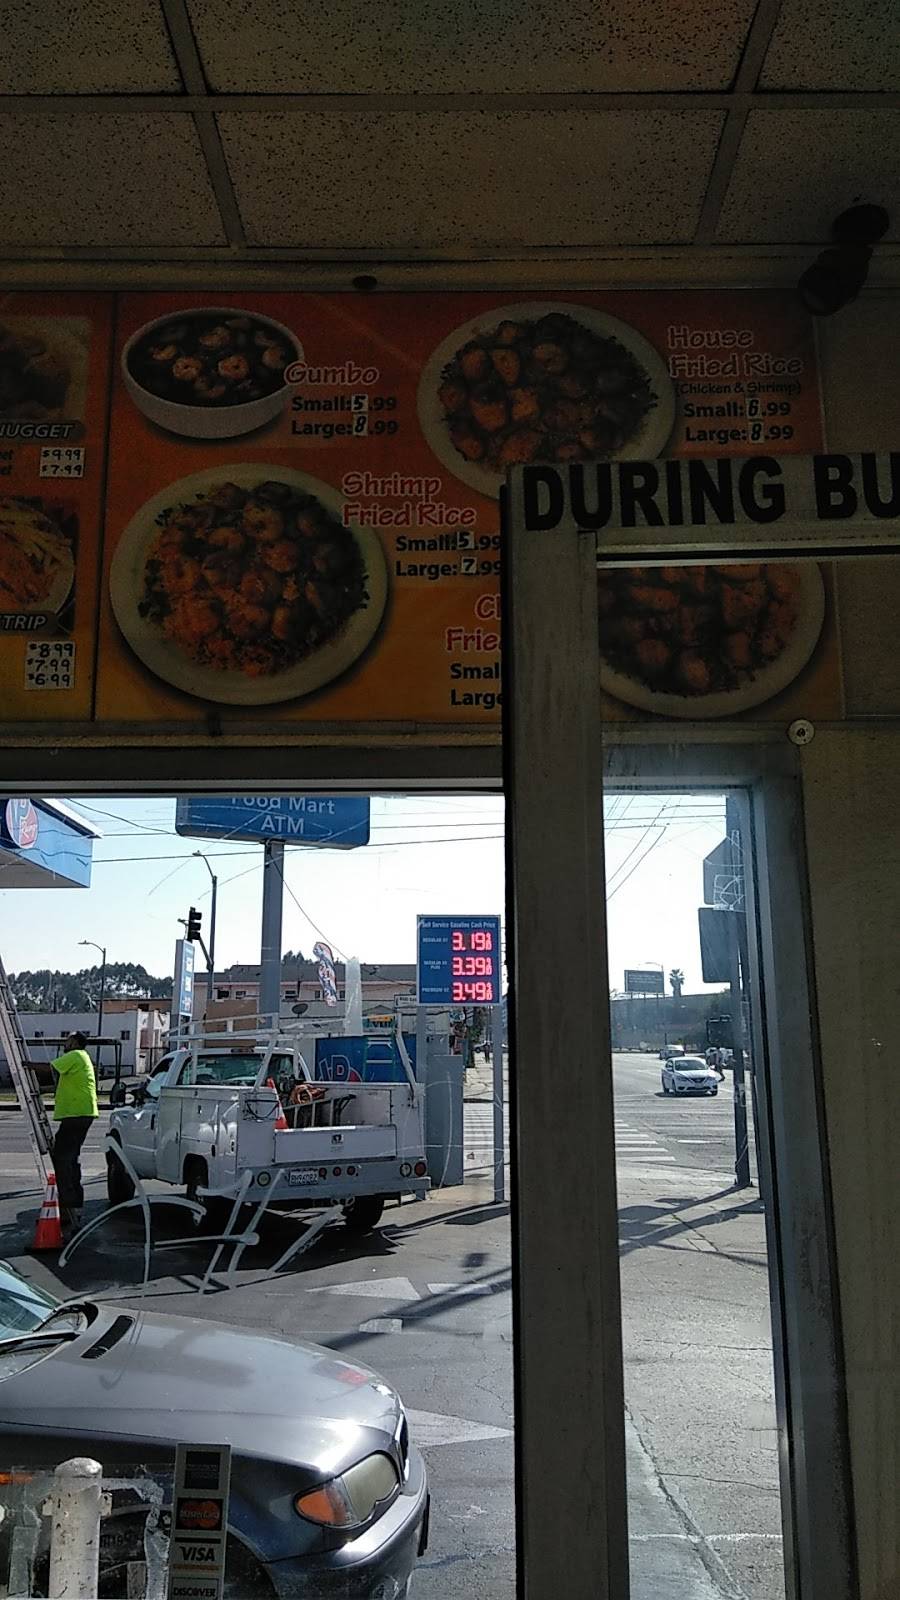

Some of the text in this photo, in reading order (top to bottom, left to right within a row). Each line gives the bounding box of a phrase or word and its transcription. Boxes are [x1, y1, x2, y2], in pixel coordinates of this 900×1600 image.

[668, 325, 754, 349] House
[284, 361, 380, 385] Gumbo
[669, 352, 804, 378] Fried Rice
[734, 384, 745, 393] &
[342, 471, 441, 504] Shrimp
[523, 453, 900, 530] DURING BU
[342, 501, 477, 527] Fried Rice
[289, 797, 335, 814] Mart
[261, 815, 305, 835] ATM
[180, 1546, 215, 1561] VISA
[173, 1587, 216, 1597] DISCOVER
